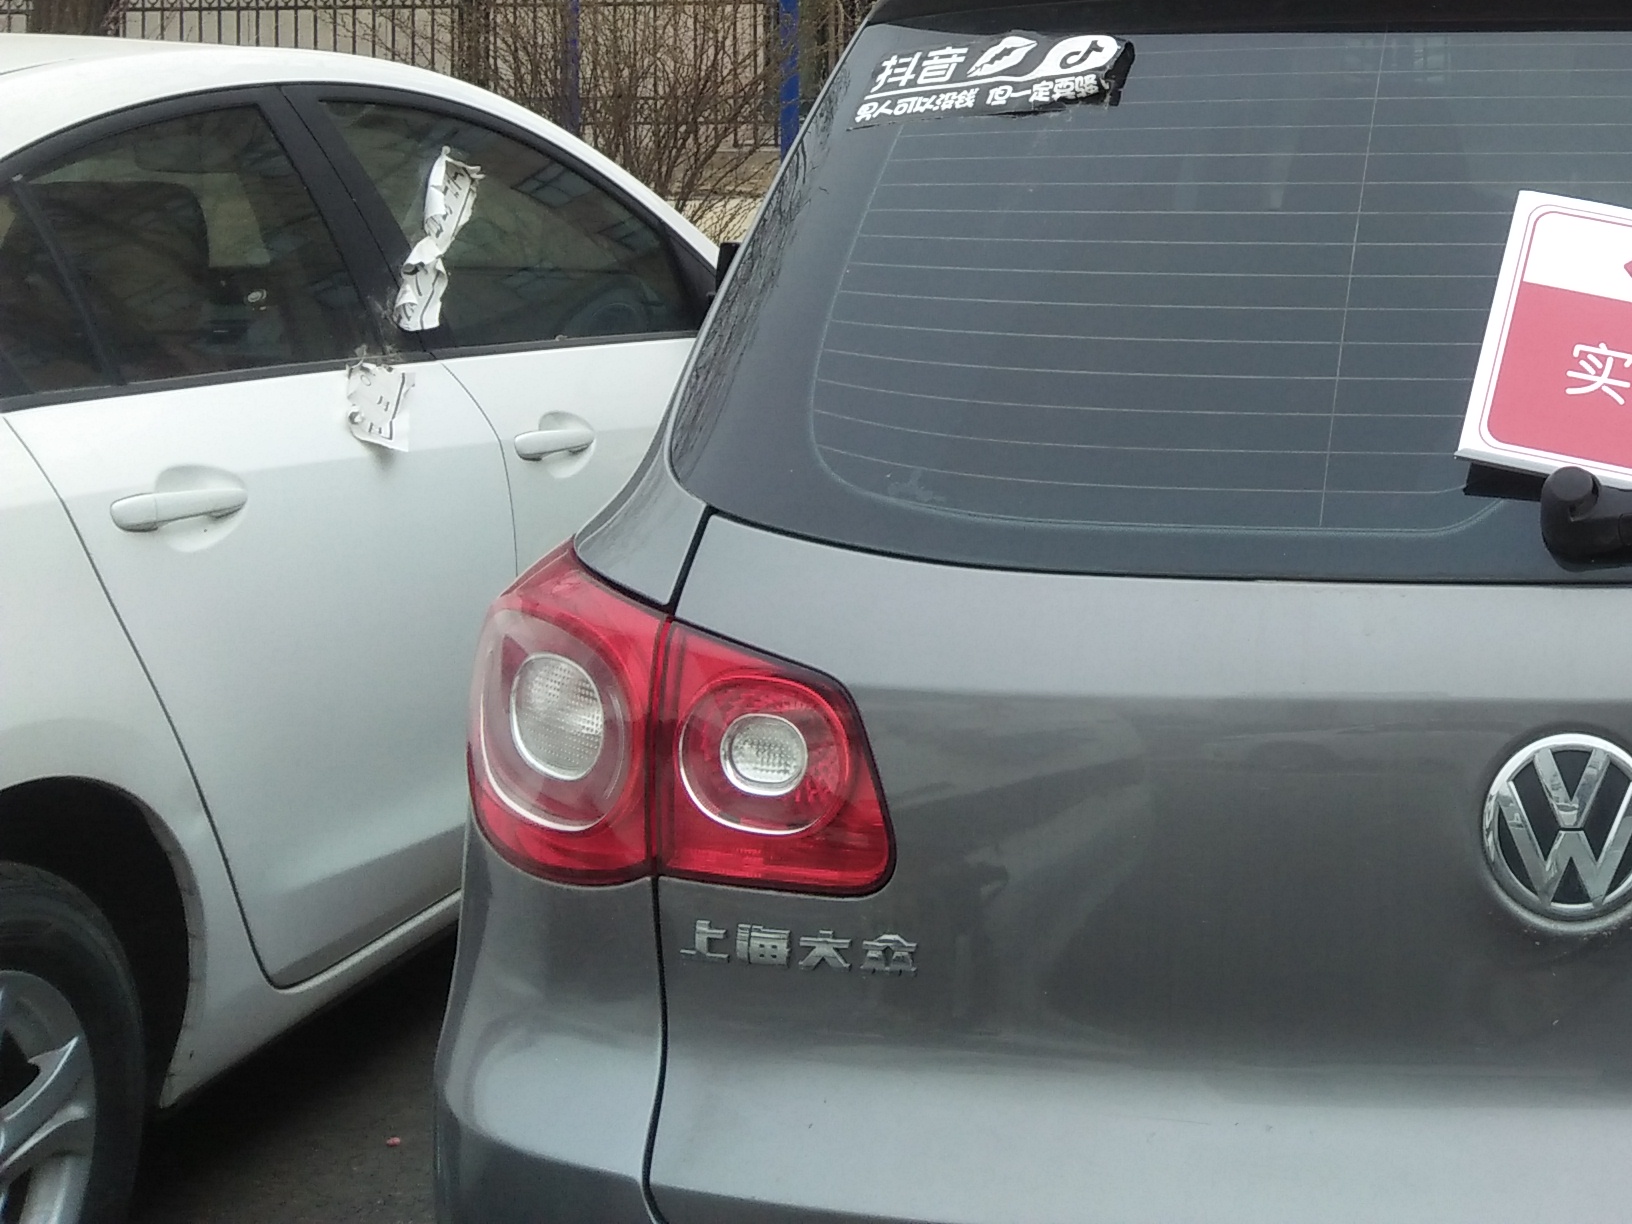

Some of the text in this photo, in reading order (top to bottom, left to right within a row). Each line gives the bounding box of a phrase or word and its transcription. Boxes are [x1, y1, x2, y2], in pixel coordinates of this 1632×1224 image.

[871, 46, 968, 92] 抖音
[855, 87, 979, 122] 男人可以没钱
[680, 920, 918, 974] 上海大众
